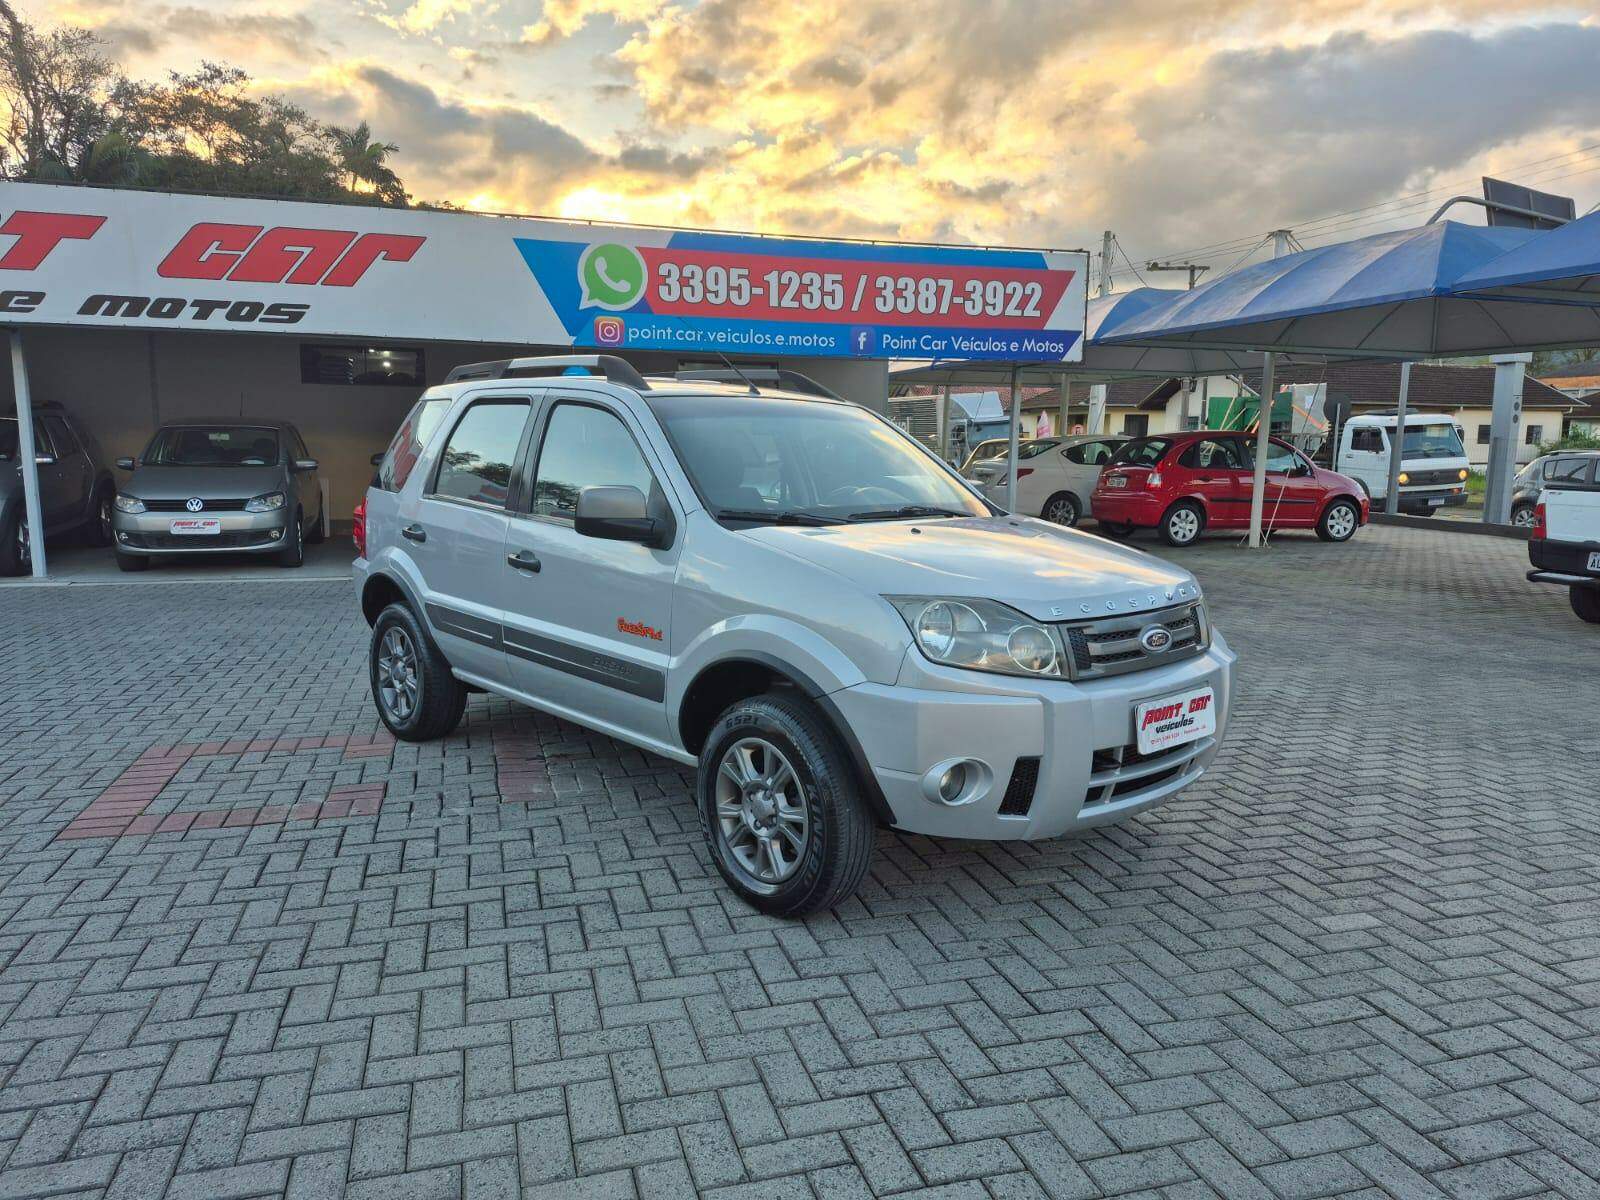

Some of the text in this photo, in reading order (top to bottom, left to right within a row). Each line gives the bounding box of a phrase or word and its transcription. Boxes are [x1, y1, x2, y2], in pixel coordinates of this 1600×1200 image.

[0, 210, 108, 270] T
[657, 262, 844, 311] 3395-1235
[875, 275, 1043, 318] 3387-3922
[628, 324, 836, 348] point.car.veiculos.e.motos
[882, 333, 917, 350] Point
[920, 335, 948, 351] Car
[950, 335, 1007, 352] Veículos
[1010, 342, 1019, 351] e
[1022, 341, 1064, 353] Motos
